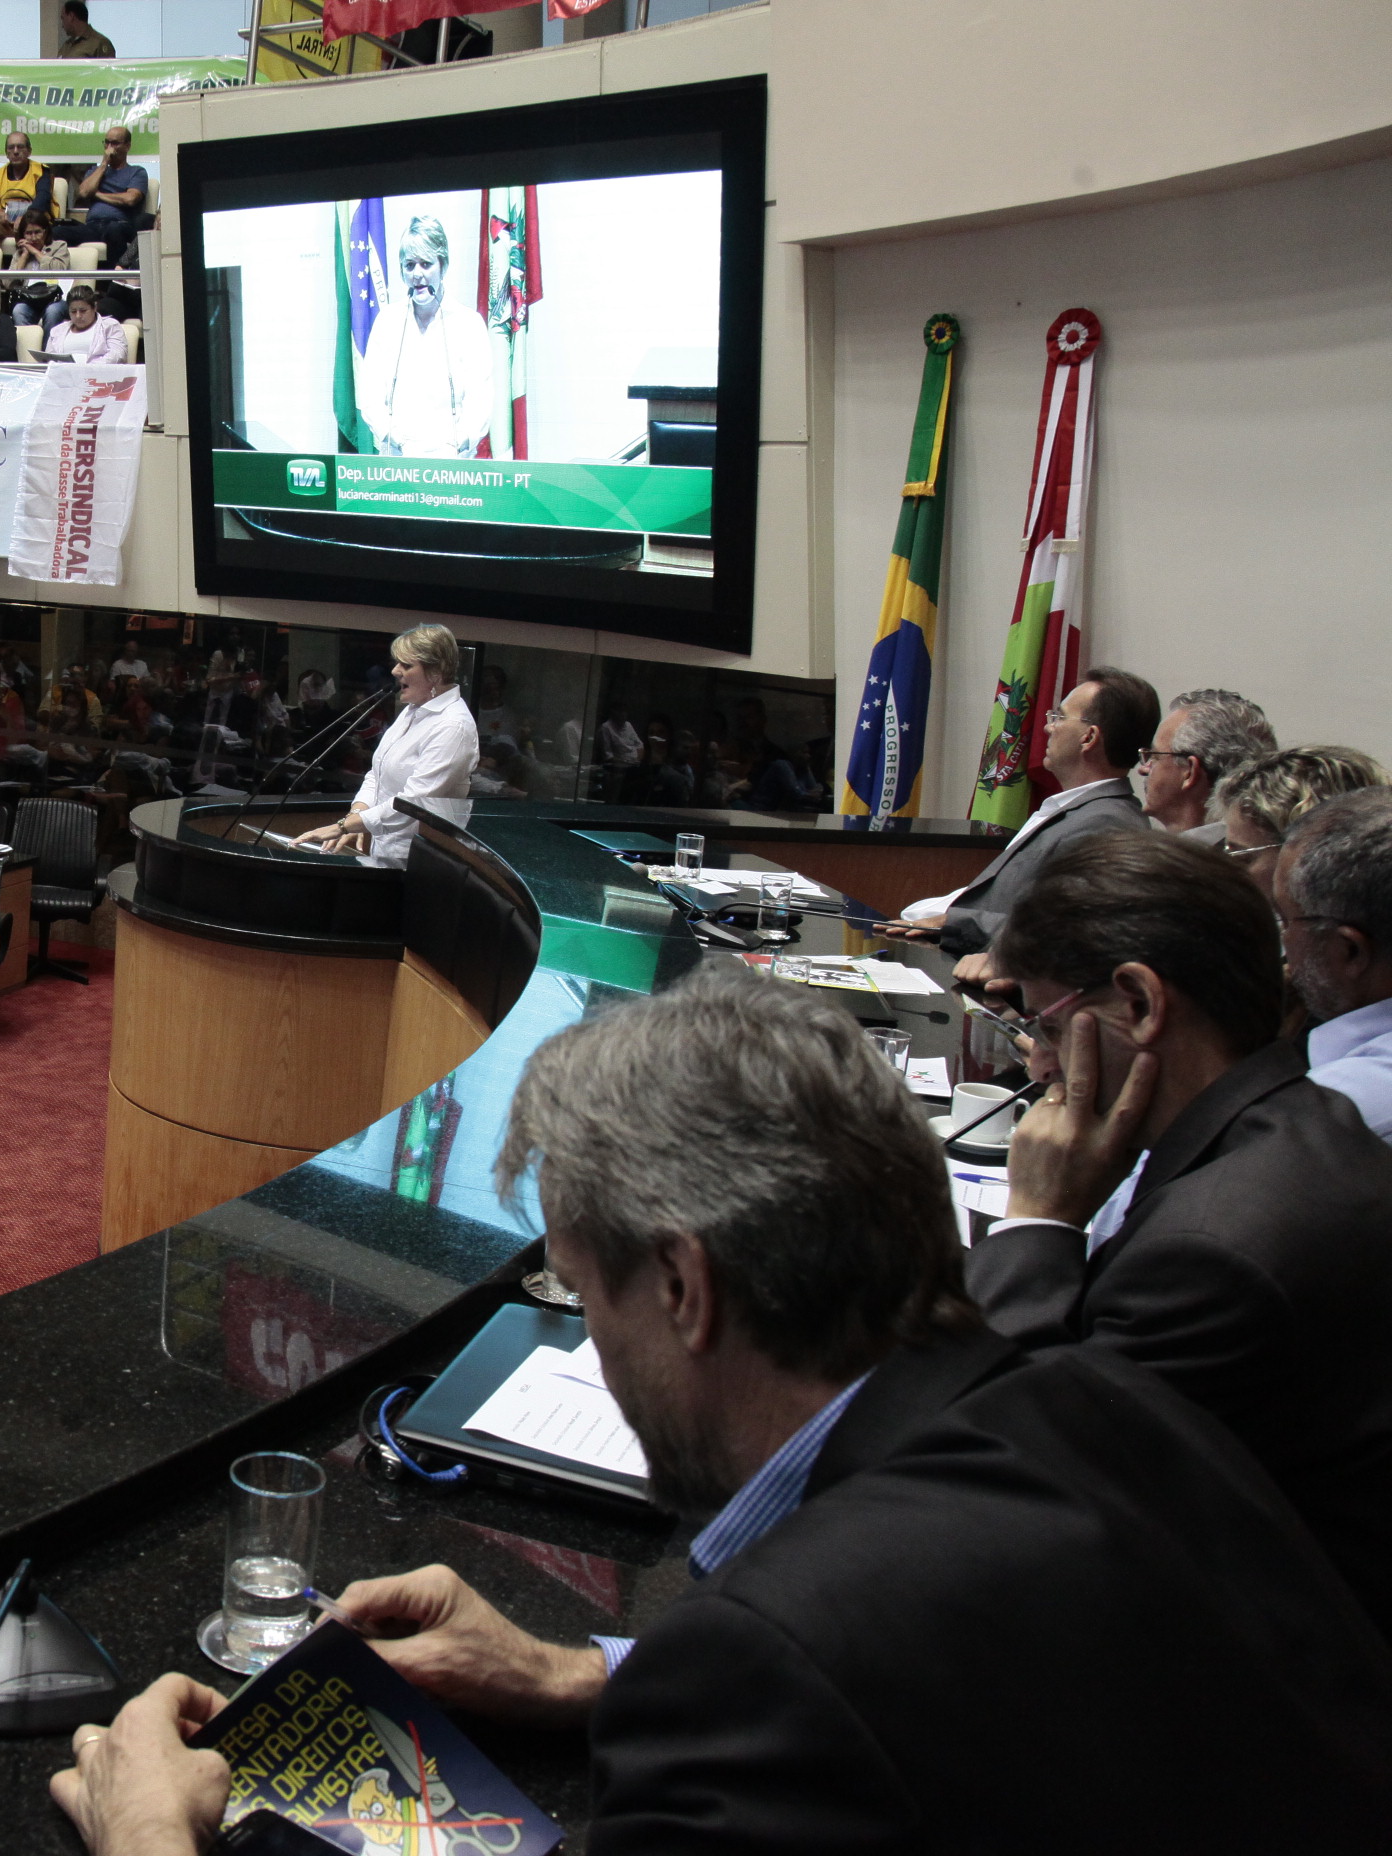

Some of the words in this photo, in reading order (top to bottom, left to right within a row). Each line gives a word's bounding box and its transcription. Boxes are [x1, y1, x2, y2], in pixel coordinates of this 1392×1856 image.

[45, 86, 74, 107] DA
[1, 121, 12, 134] a
[16, 116, 95, 134] Reforma
[62, 406, 83, 441] Central
[60, 444, 71, 458] da
[57, 460, 71, 499] Classe
[65, 405, 105, 580] INTERSINDICAL
[337, 466, 365, 482] Dep.
[367, 467, 420, 484] LUCIANE
[422, 469, 503, 487] CARMINATTI
[514, 473, 531, 489] PT
[337, 488, 483, 507] lucianecarminatti13@gmail.com
[51, 500, 71, 579] Trabalhadora
[881, 704, 898, 811] PROGRESSO
[275, 1669, 317, 1706] DA
[227, 1677, 353, 1808] SENTADORIA
[271, 1705, 367, 1801] DIREITOS
